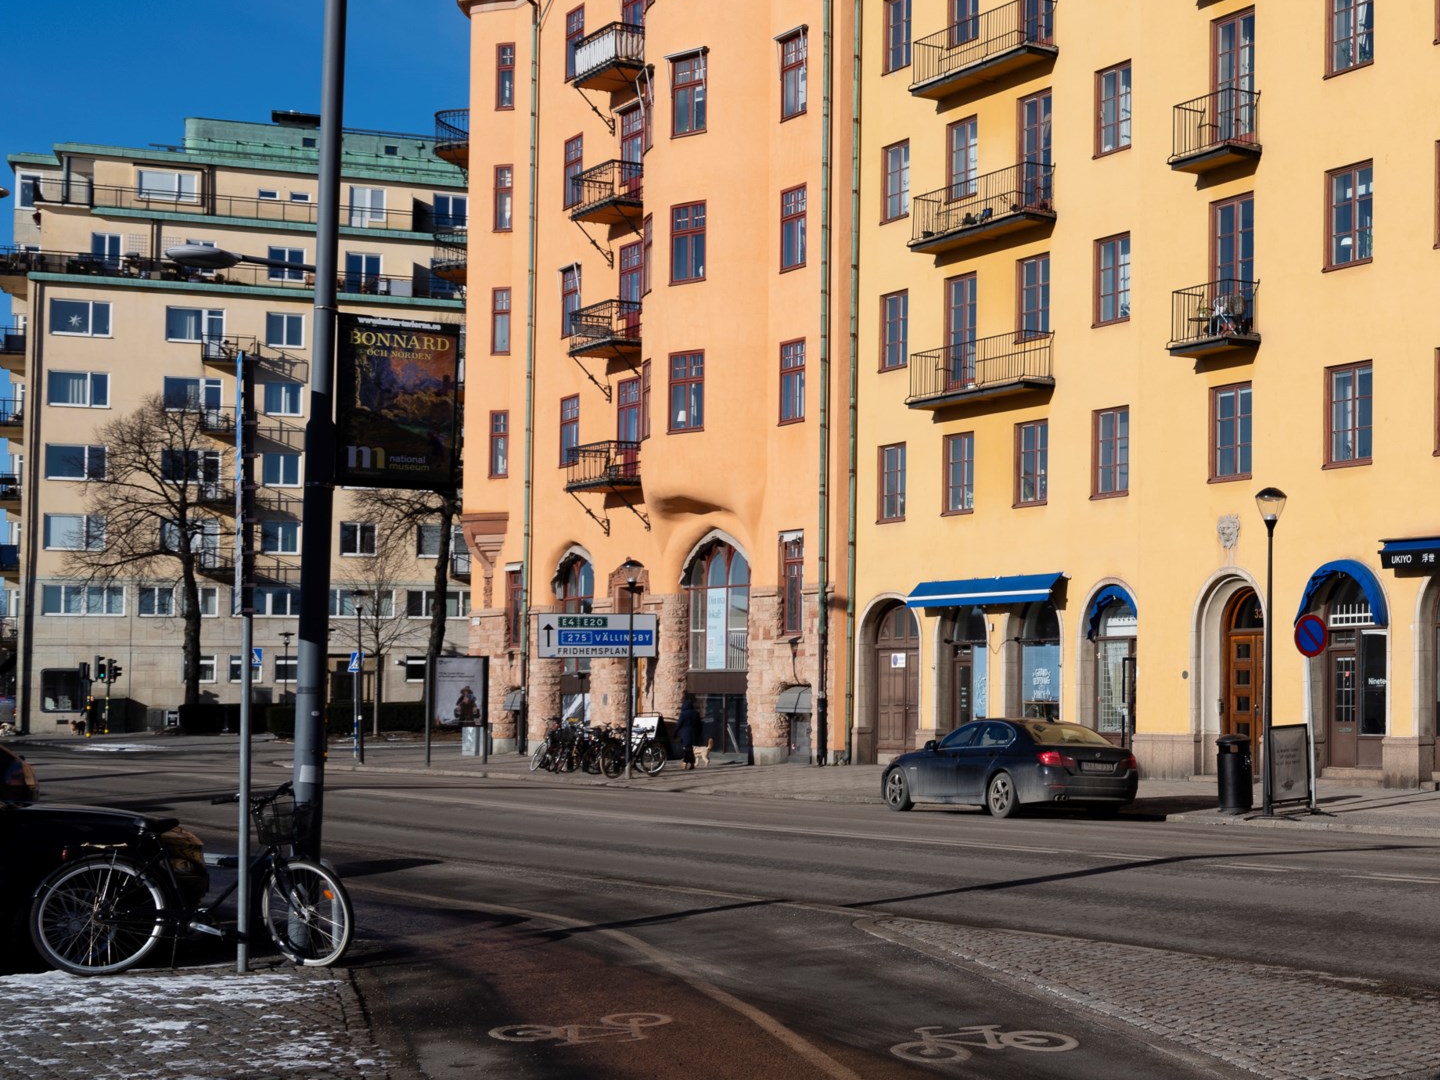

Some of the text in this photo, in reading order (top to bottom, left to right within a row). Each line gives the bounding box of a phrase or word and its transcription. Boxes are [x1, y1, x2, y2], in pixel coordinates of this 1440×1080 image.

[350, 329, 450, 352] BONNARD
[366, 347, 432, 361] OCH NORDEN
[389, 454, 426, 464] national
[388, 463, 430, 472] museum
[1391, 554, 1413, 565] UKIYO
[562, 618, 604, 626] E4 E20
[567, 631, 651, 642] 275 VÄLLINGBY
[557, 647, 628, 655] FRIDHEMSPLAN
